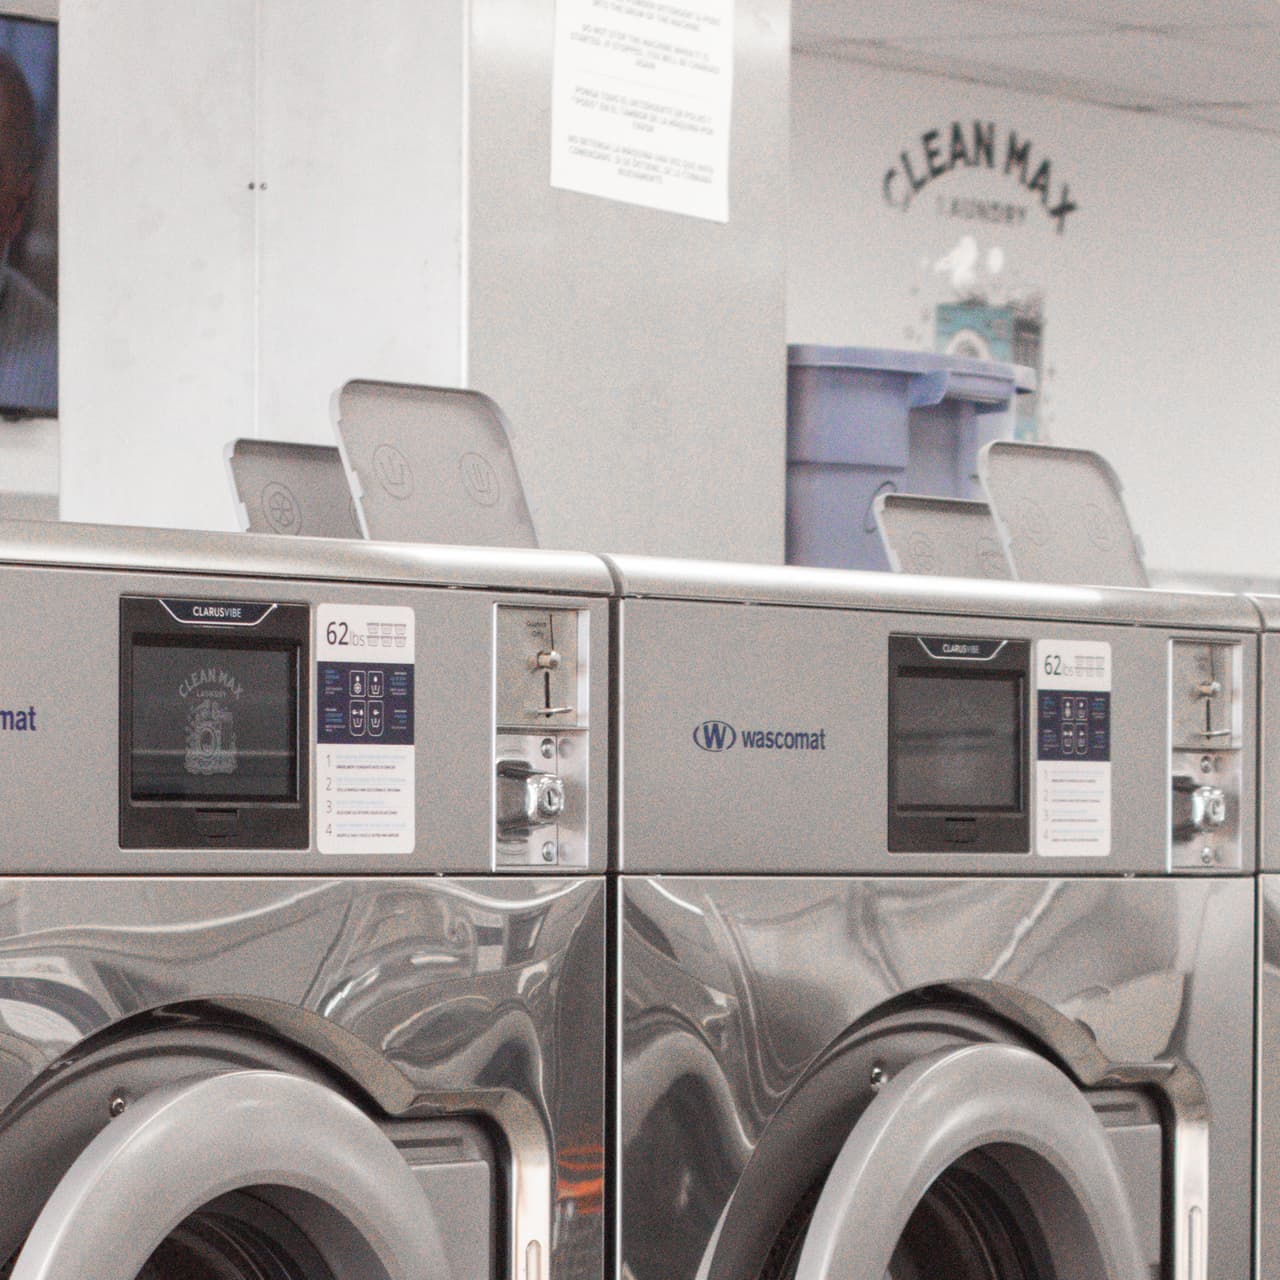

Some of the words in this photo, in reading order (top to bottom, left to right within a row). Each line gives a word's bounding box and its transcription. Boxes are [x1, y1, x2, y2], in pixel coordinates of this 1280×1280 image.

[882, 119, 995, 213] CLEAN
[1004, 130, 1078, 235] MAX
[179, 668, 217, 698] CLEAN
[219, 669, 243, 700] MAX
[741, 728, 826, 750] wascomat
